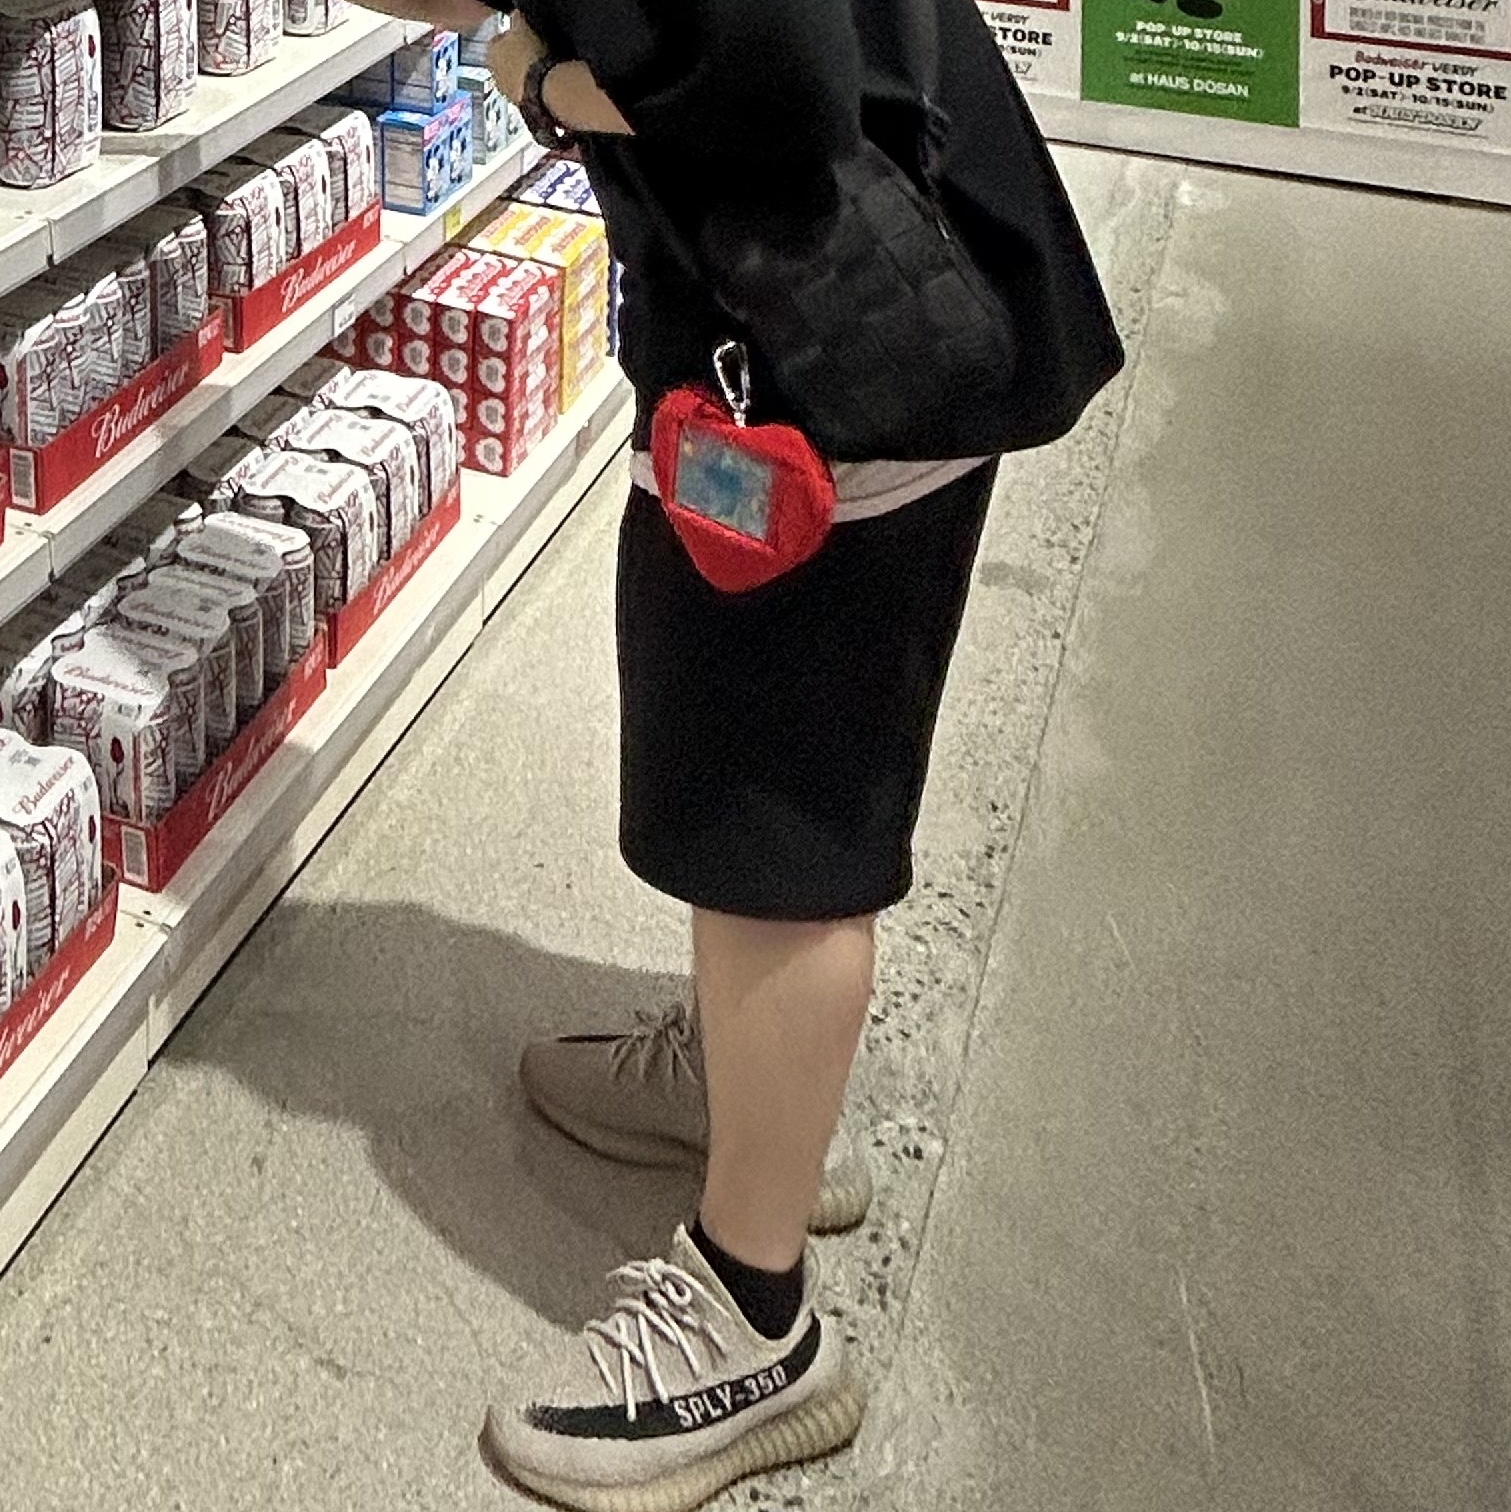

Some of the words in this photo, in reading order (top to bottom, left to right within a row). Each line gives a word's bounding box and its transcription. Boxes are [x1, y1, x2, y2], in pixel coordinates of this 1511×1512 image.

[1147, 72, 1190, 90] HAUS
[1193, 78, 1250, 98] DOSAN
[1329, 64, 1420, 89] POP-UP
[1425, 75, 1508, 101] STORE
[281, 240, 357, 313] Budweiser
[92, 363, 189, 459] Budweiser
[12, 756, 74, 817] Budweiser
[672, 1364, 787, 1429] SPLY-350
